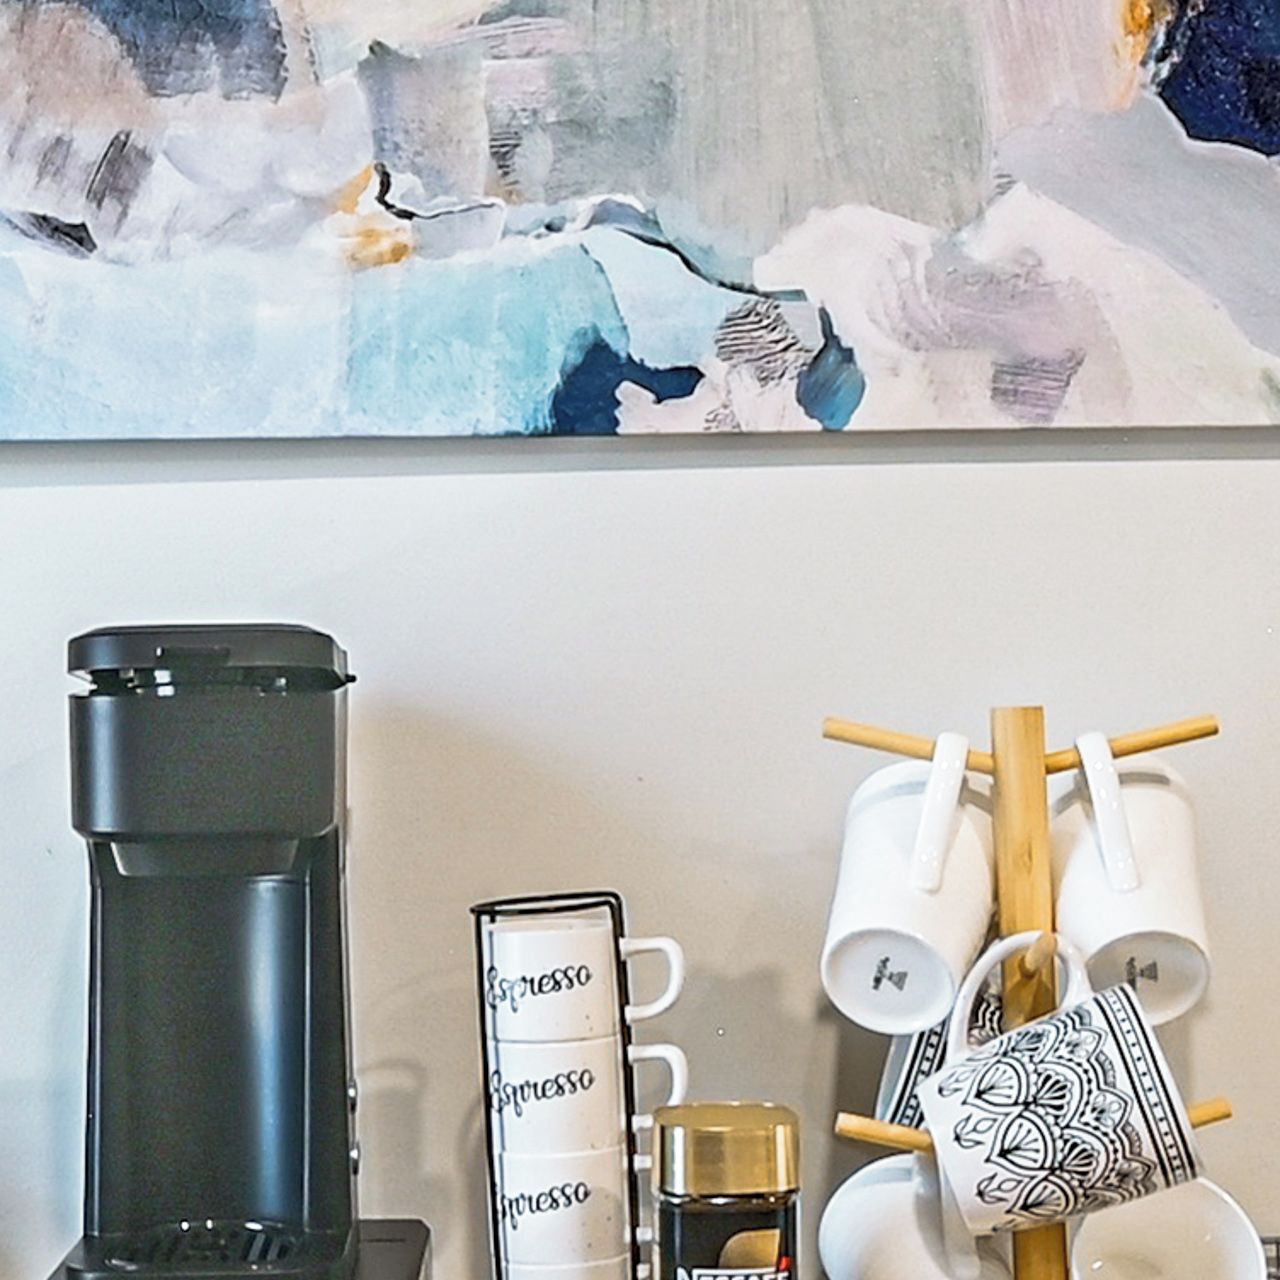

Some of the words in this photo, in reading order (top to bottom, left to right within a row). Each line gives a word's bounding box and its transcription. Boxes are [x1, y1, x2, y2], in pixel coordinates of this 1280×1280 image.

[486, 965, 593, 1013] Espresso
[490, 1068, 596, 1118] Espresso
[497, 1181, 592, 1231] spresso
